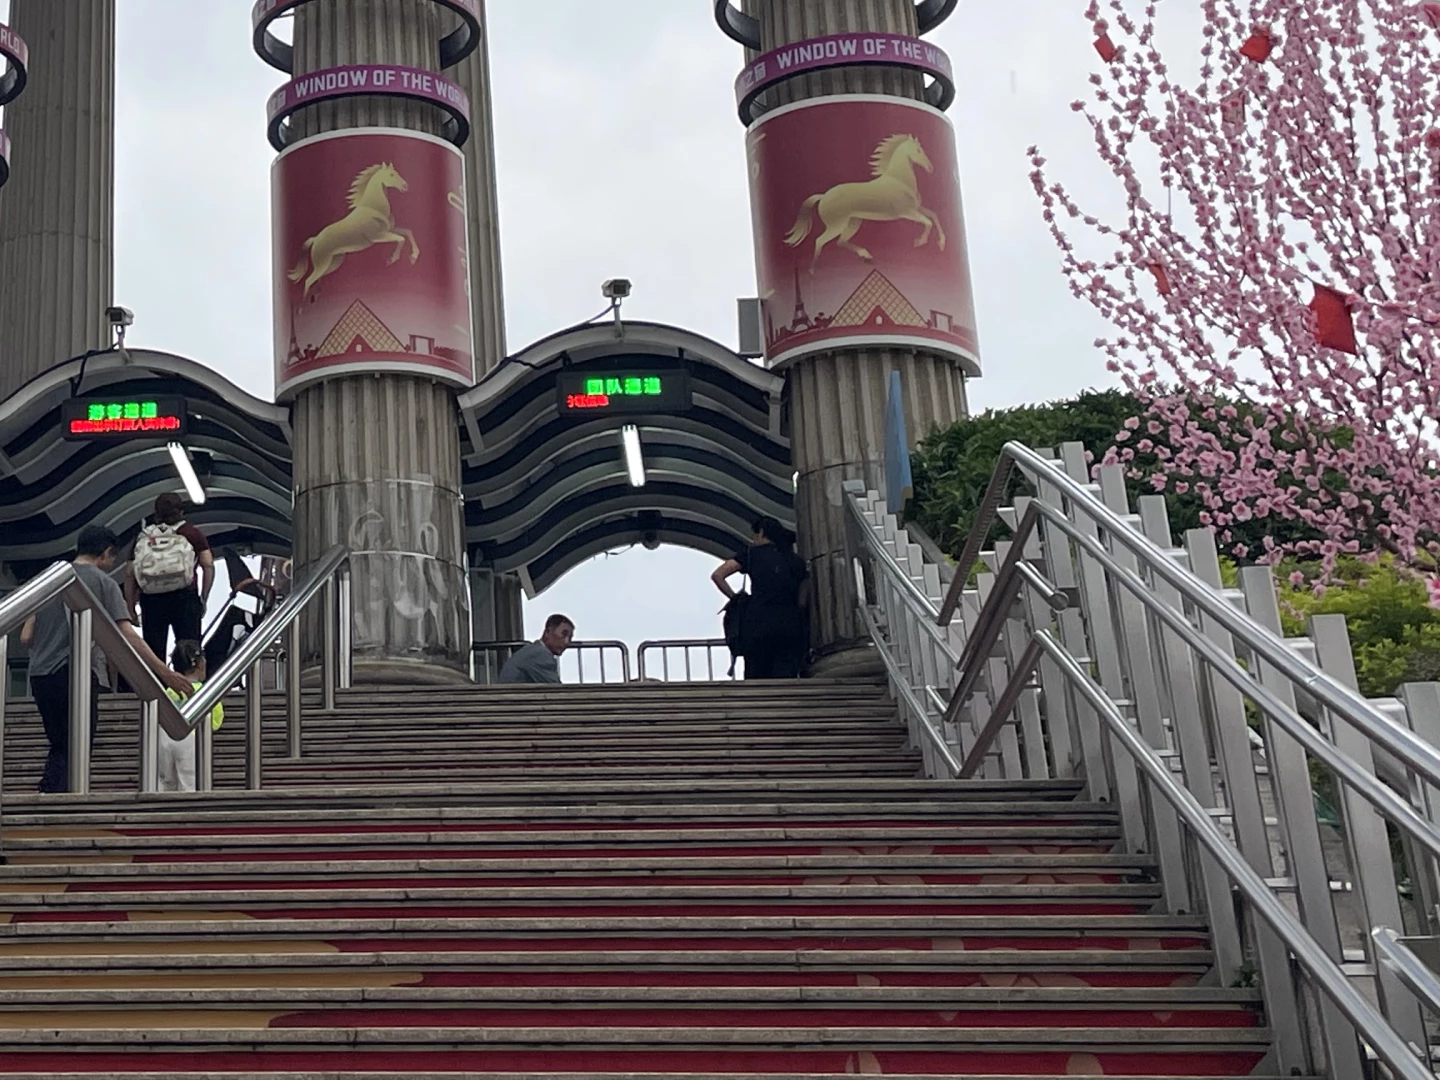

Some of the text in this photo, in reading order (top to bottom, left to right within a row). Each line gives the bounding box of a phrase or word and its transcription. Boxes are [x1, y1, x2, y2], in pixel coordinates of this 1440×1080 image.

[776, 39, 857, 69] WINDOW
[863, 38, 886, 55] OF
[891, 40, 922, 60] THE
[295, 70, 367, 98] WINDOW
[373, 70, 395, 86] OF
[401, 71, 432, 92] THE
